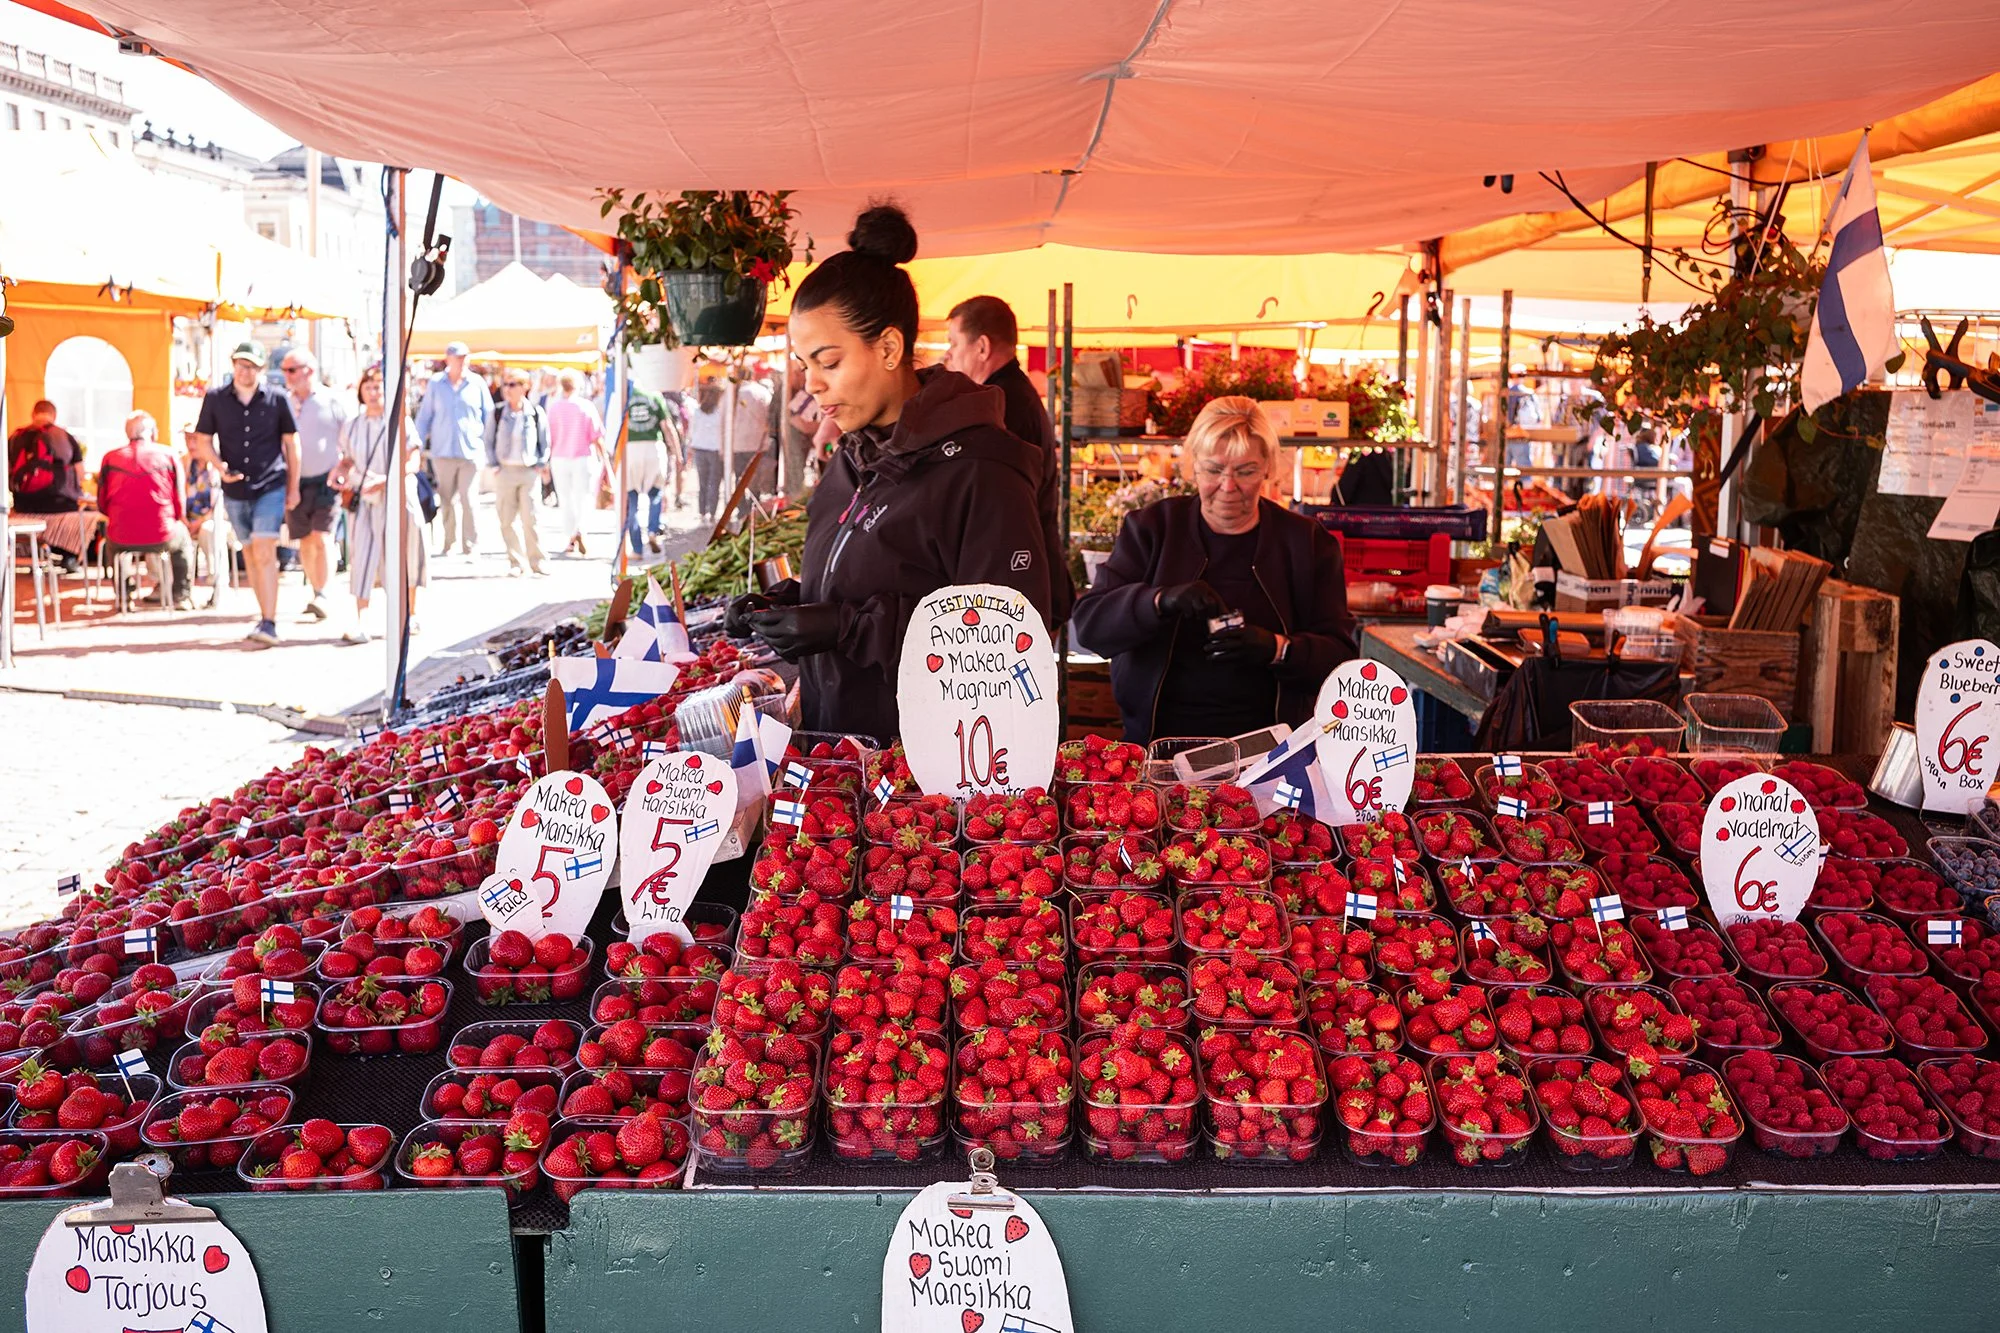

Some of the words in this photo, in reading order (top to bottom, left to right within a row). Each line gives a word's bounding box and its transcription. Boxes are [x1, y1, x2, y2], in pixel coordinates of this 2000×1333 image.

[924, 594, 1026, 618] TESTIVOITTAJA
[930, 623, 1014, 647] Avomaan
[948, 650, 1007, 674] Makea
[1954, 652, 2000, 673] Sweet
[939, 678, 1013, 710] Magnum
[1337, 676, 1390, 705] Makea
[1353, 703, 1396, 723] Suomi
[1332, 722, 1397, 746] Mansikka
[1938, 701, 1990, 776] 6€
[954, 715, 1010, 790] 10€
[656, 762, 706, 785] Makea
[1345, 746, 1384, 811] 6€
[1925, 756, 1947, 790] Spain
[1959, 774, 1985, 790] Box
[533, 784, 588, 820] Makea
[665, 782, 707, 802] Suomi
[535, 817, 606, 852] Mansikka
[1734, 845, 1780, 913] 6€
[74, 1226, 197, 1264] Mansikka
[909, 1218, 994, 1251] Makea
[938, 1250, 1012, 1278] Suomi
[94, 1274, 208, 1318] Tarjous
[909, 1277, 1032, 1311] Mansikka
